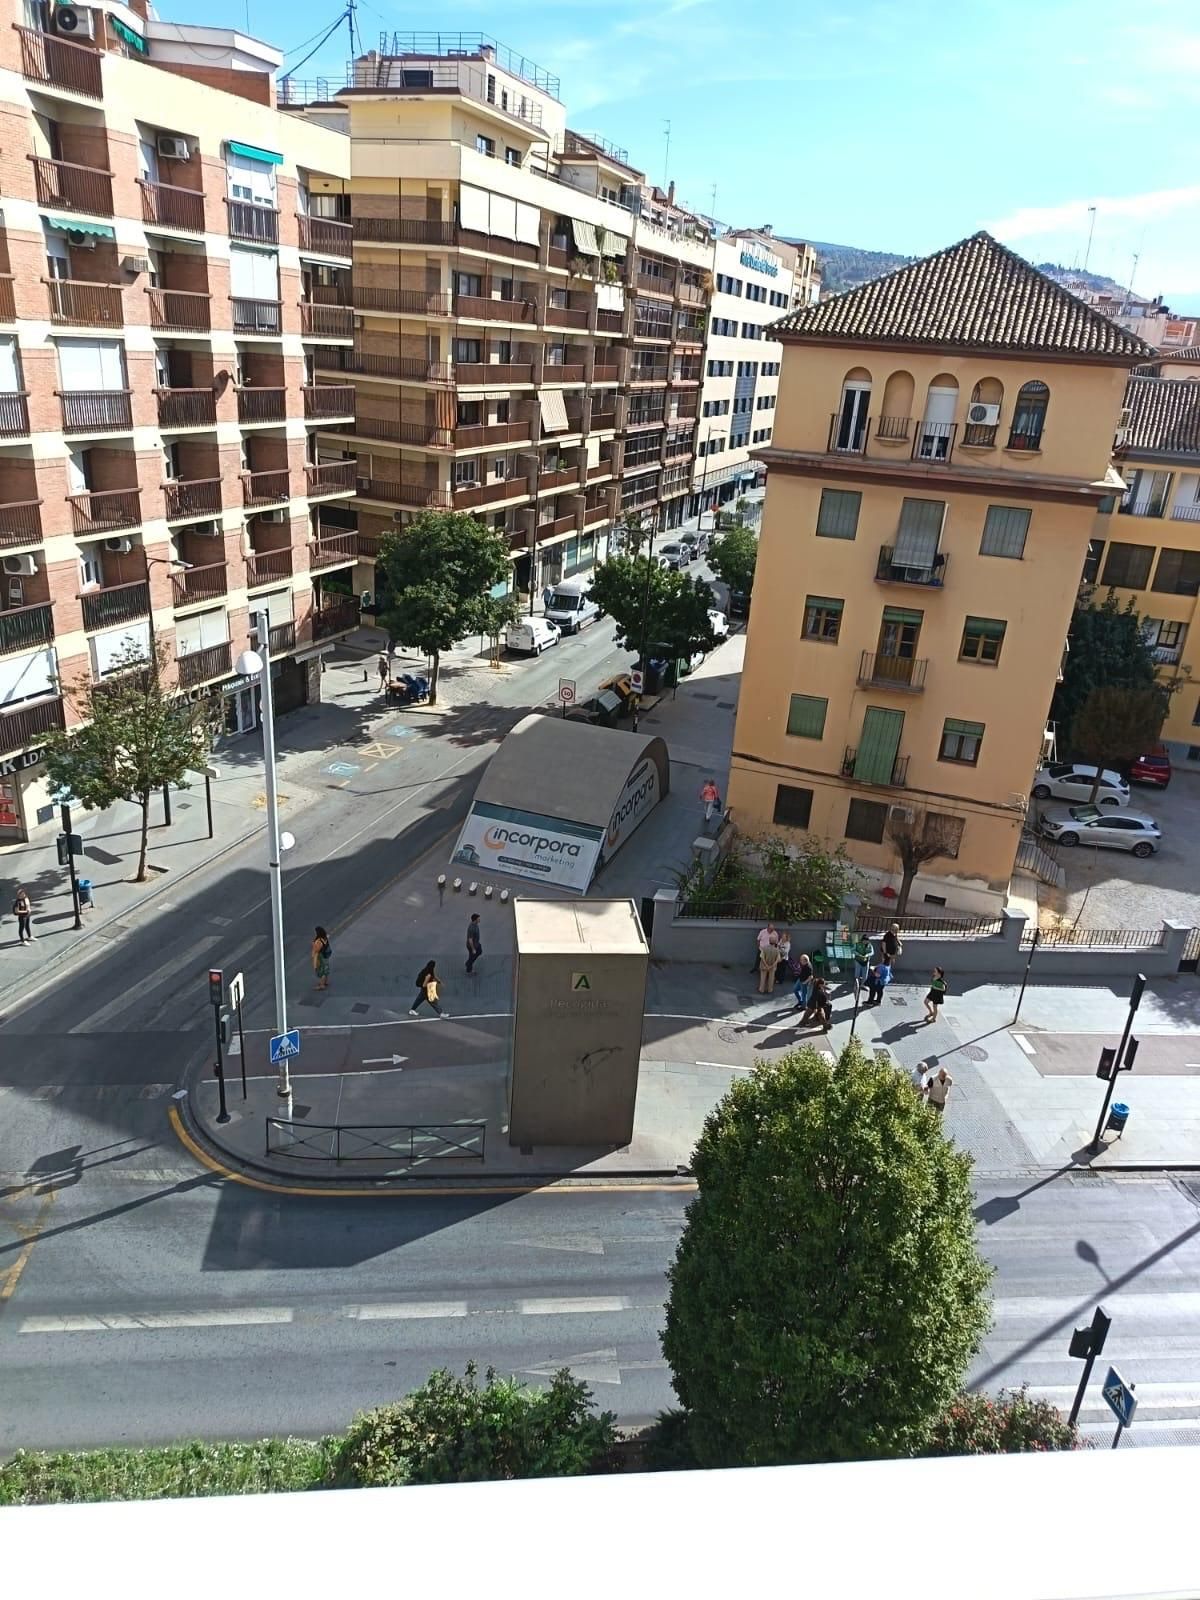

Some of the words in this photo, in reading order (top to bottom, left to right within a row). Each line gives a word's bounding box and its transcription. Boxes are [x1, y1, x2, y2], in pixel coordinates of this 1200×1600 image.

[612, 774, 655, 832] incorpora
[492, 827, 581, 857] incorpora
[534, 853, 575, 869] marketing
